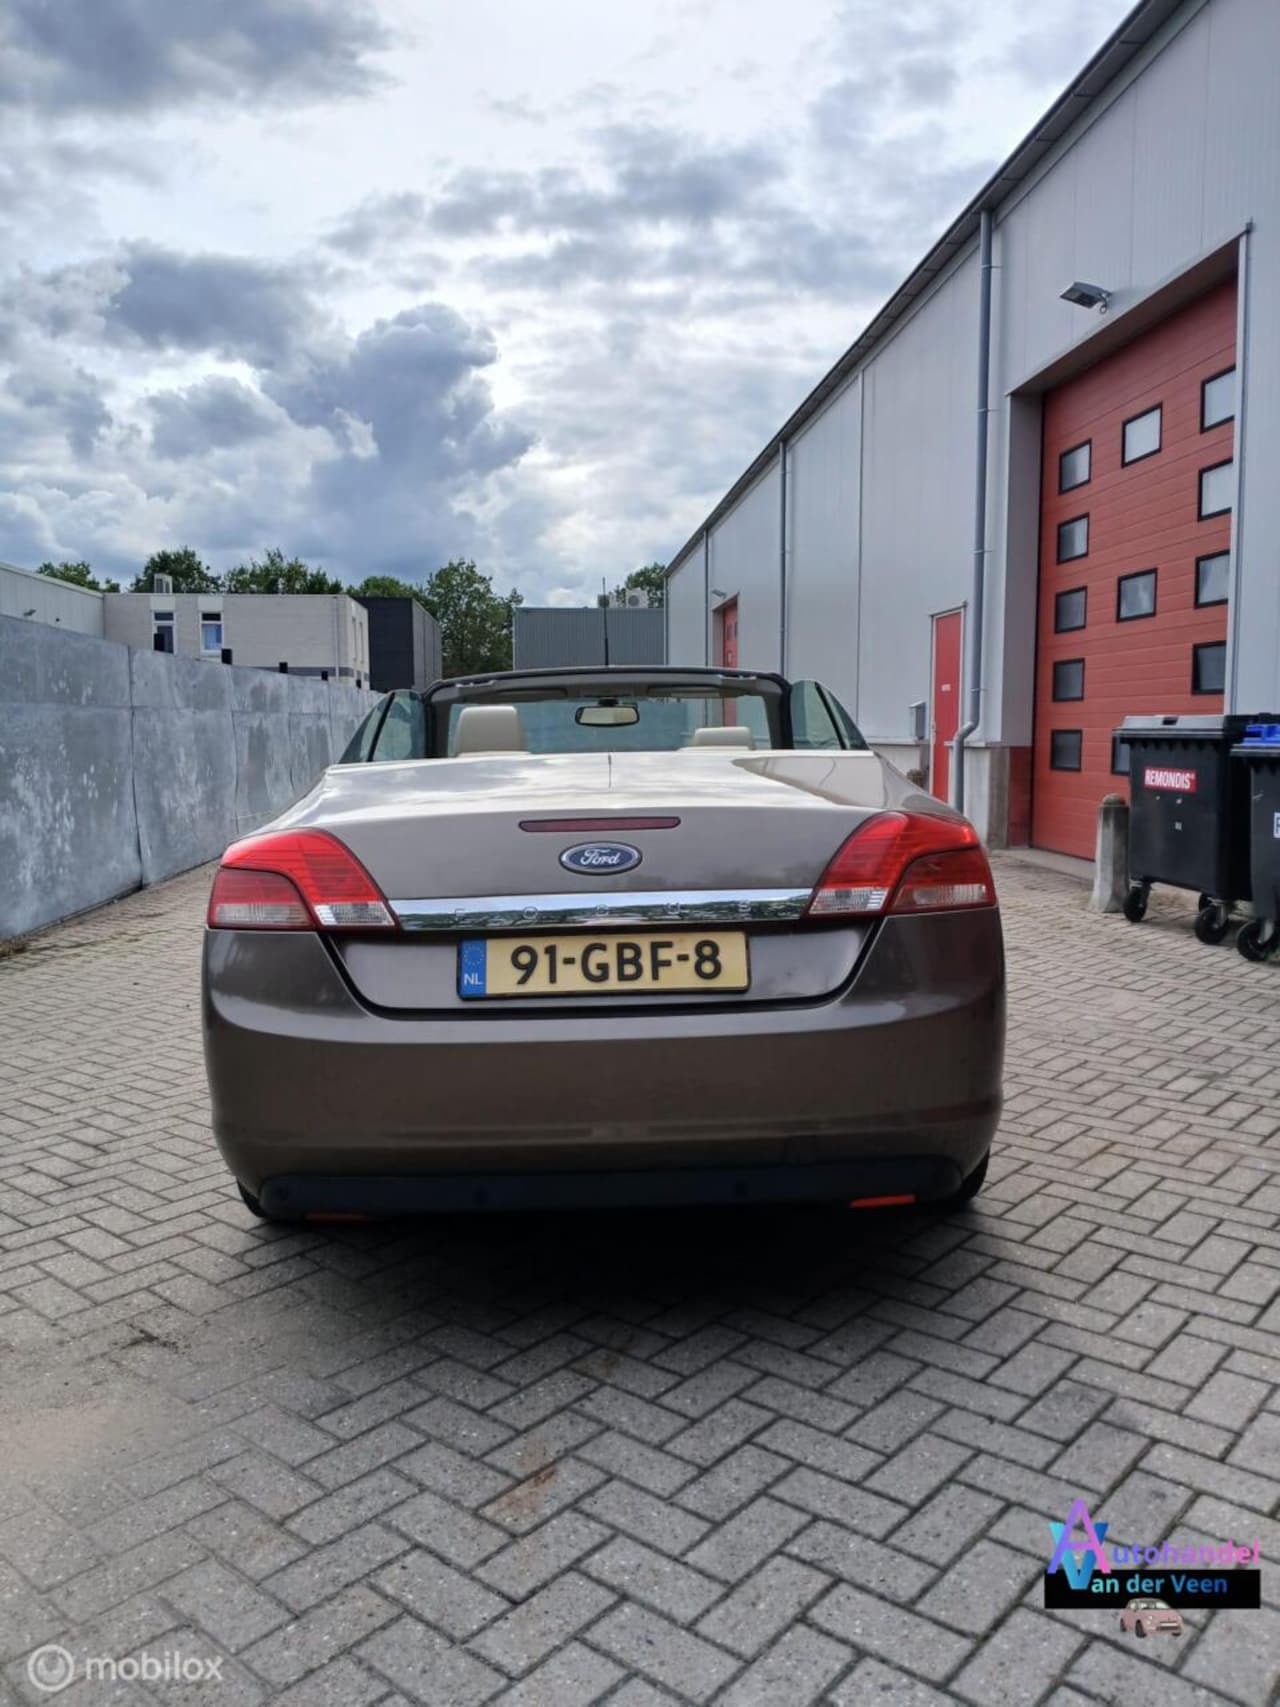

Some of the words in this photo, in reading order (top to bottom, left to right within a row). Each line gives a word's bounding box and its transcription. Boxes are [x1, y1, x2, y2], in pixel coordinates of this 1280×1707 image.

[1144, 769, 1191, 790] REMONDIS
[580, 848, 621, 865] Ford
[510, 939, 722, 985] 91-GBF-8
[464, 973, 483, 986] NL
